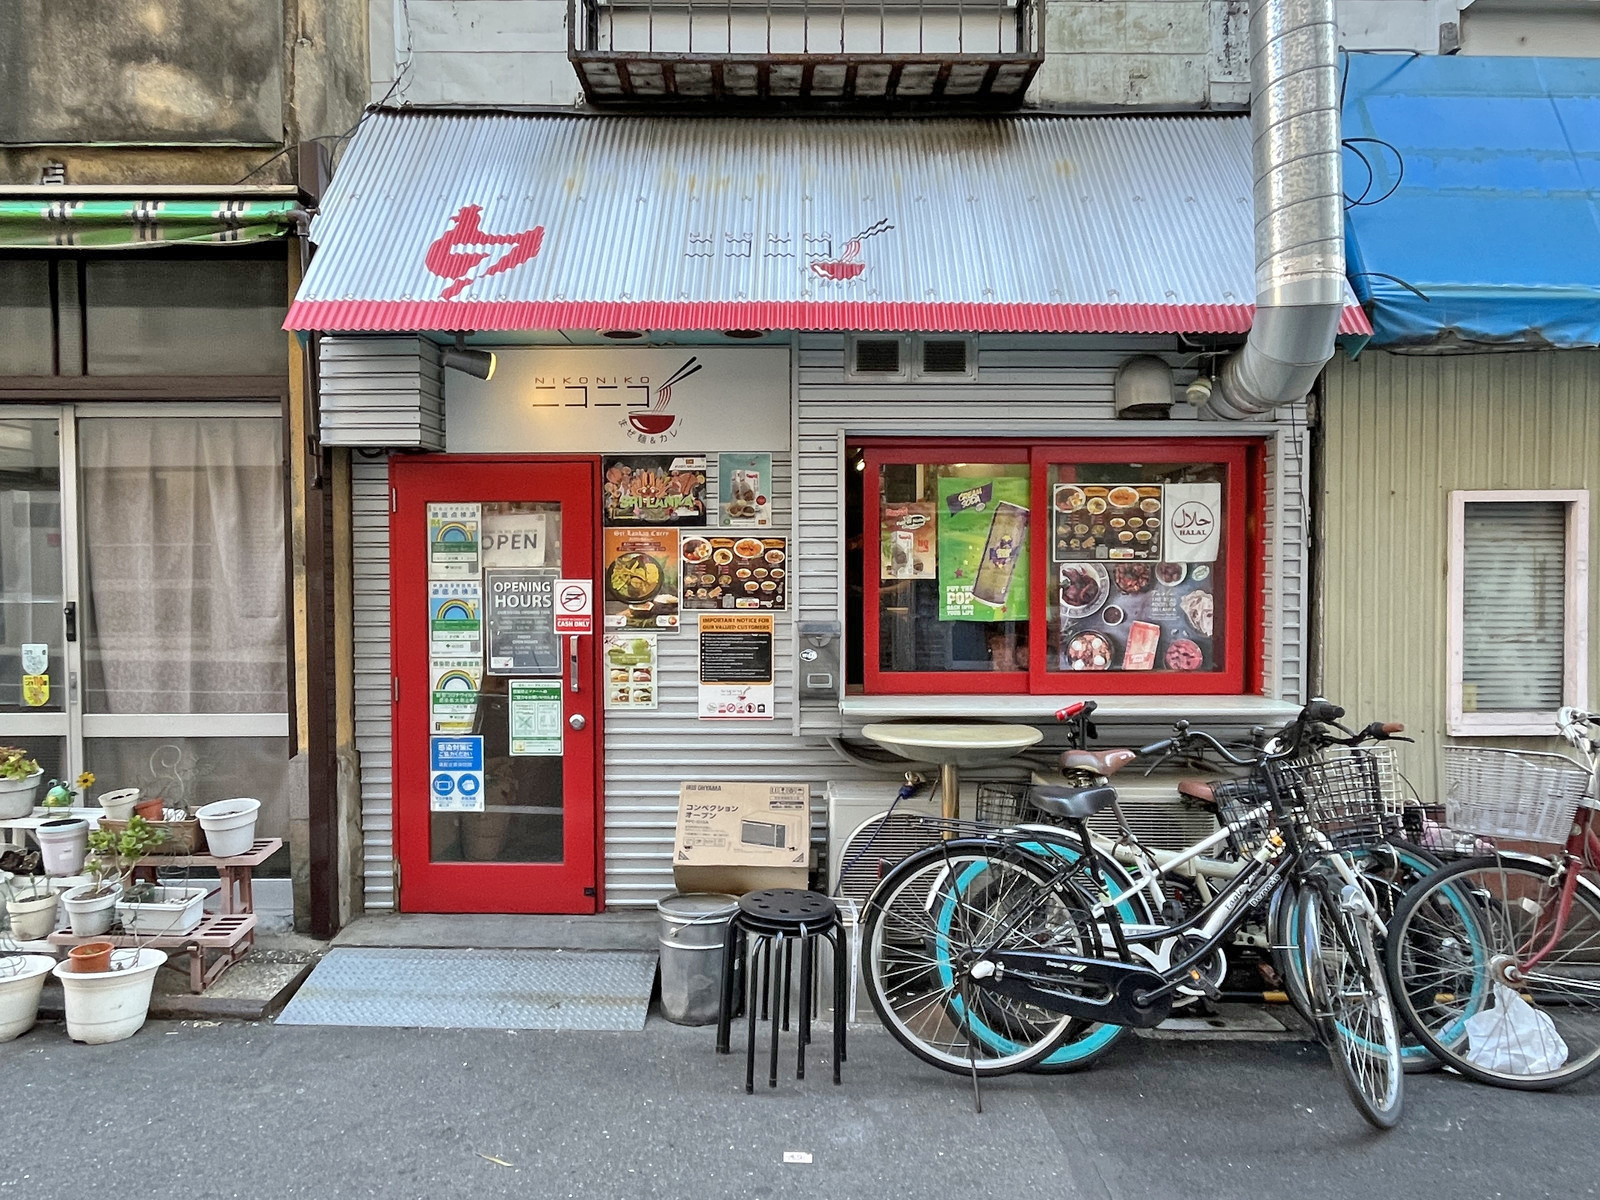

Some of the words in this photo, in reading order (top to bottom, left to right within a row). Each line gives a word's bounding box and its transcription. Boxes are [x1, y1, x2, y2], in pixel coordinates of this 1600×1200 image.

[535, 376, 650, 384] NIKONIKO
[532, 385, 650, 409] ニコニコ
[620, 495, 643, 508] SRI
[647, 493, 695, 508] LANKA
[958, 487, 983, 502] CREAM
[960, 494, 982, 509] SODA
[1174, 508, 1212, 529] حلال
[482, 533, 538, 551] OPEN
[494, 581, 551, 593] OPENING
[495, 594, 552, 608] HOURS
[946, 591, 975, 605] POP
[557, 620, 573, 628] CASH
[574, 620, 590, 628] ONLY
[685, 811, 717, 819] オーブン
[686, 804, 739, 812] コンベクション
